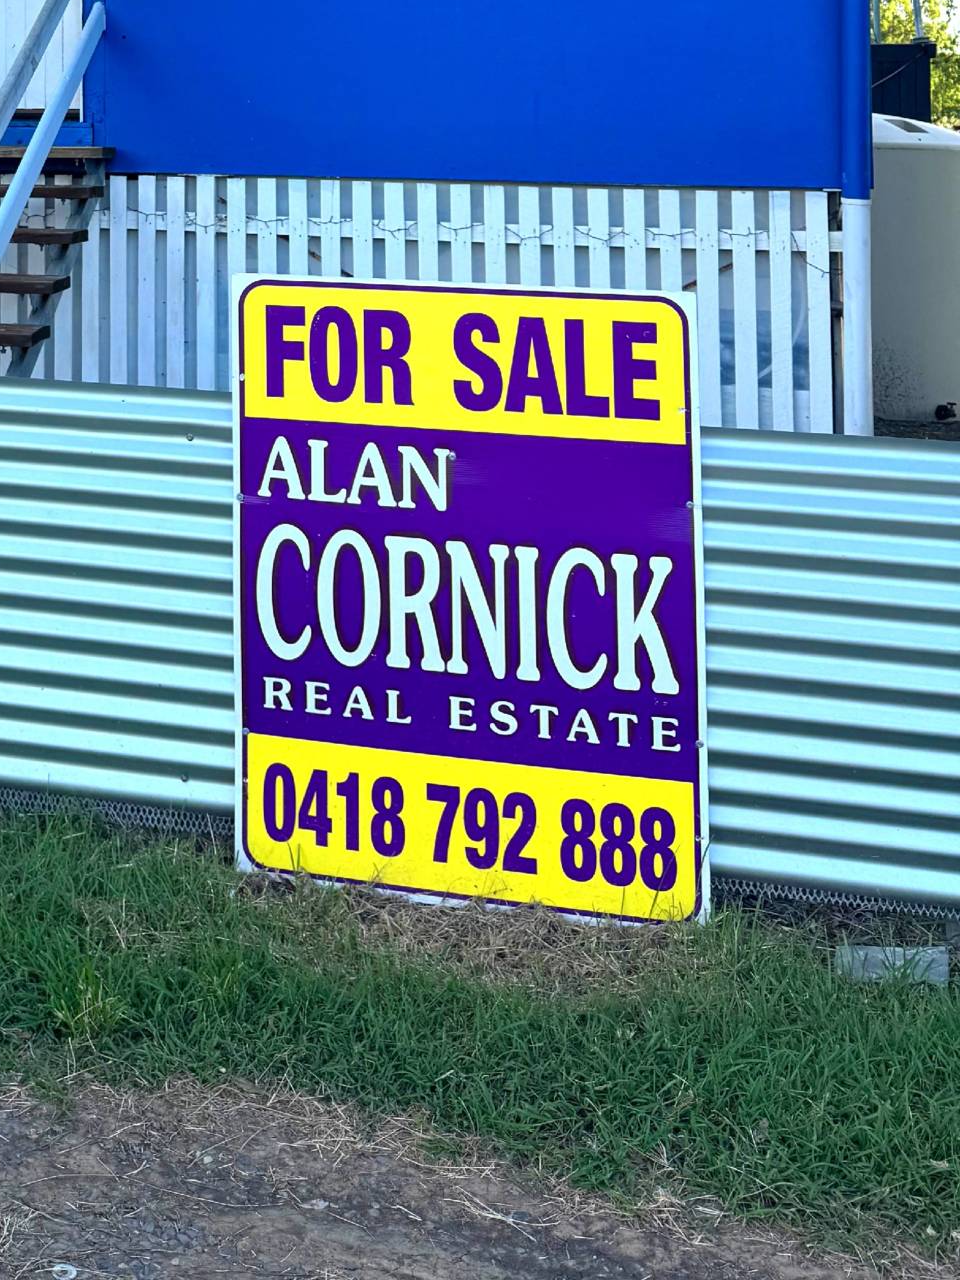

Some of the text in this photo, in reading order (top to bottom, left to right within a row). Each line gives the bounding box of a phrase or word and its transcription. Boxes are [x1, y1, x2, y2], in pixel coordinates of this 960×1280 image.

[265, 304, 661, 421] FOR SALE
[257, 435, 450, 512] ALAN
[256, 523, 680, 695] CORNICK
[263, 676, 681, 752] REAL ESTATE
[263, 762, 678, 892] 0418 792 888
